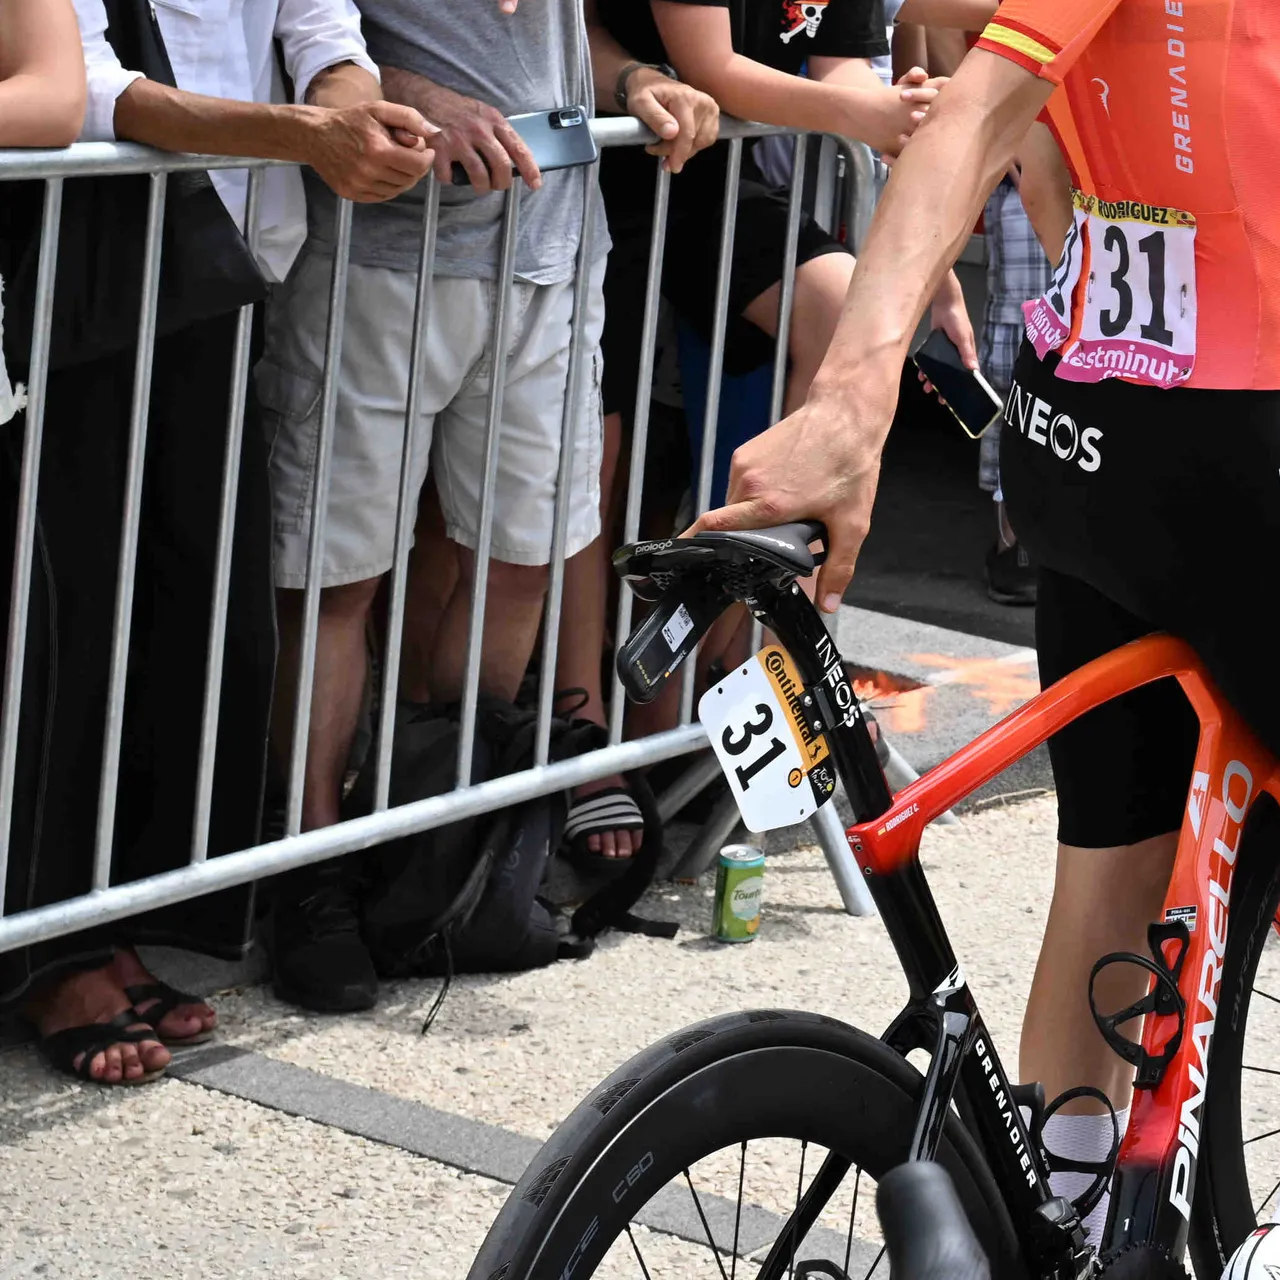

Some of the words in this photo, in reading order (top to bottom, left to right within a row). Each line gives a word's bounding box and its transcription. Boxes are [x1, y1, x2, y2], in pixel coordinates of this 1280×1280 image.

[1098, 200, 1168, 224] RODRIGUEZ
[1099, 225, 1173, 347] 31
[1005, 380, 1104, 472] INEOS
[765, 650, 813, 750] Continental
[815, 634, 860, 728] INEOS
[722, 703, 787, 793] 31
[1170, 760, 1253, 1223] PINARELLO
[975, 1039, 1037, 1188] GRENADIER
